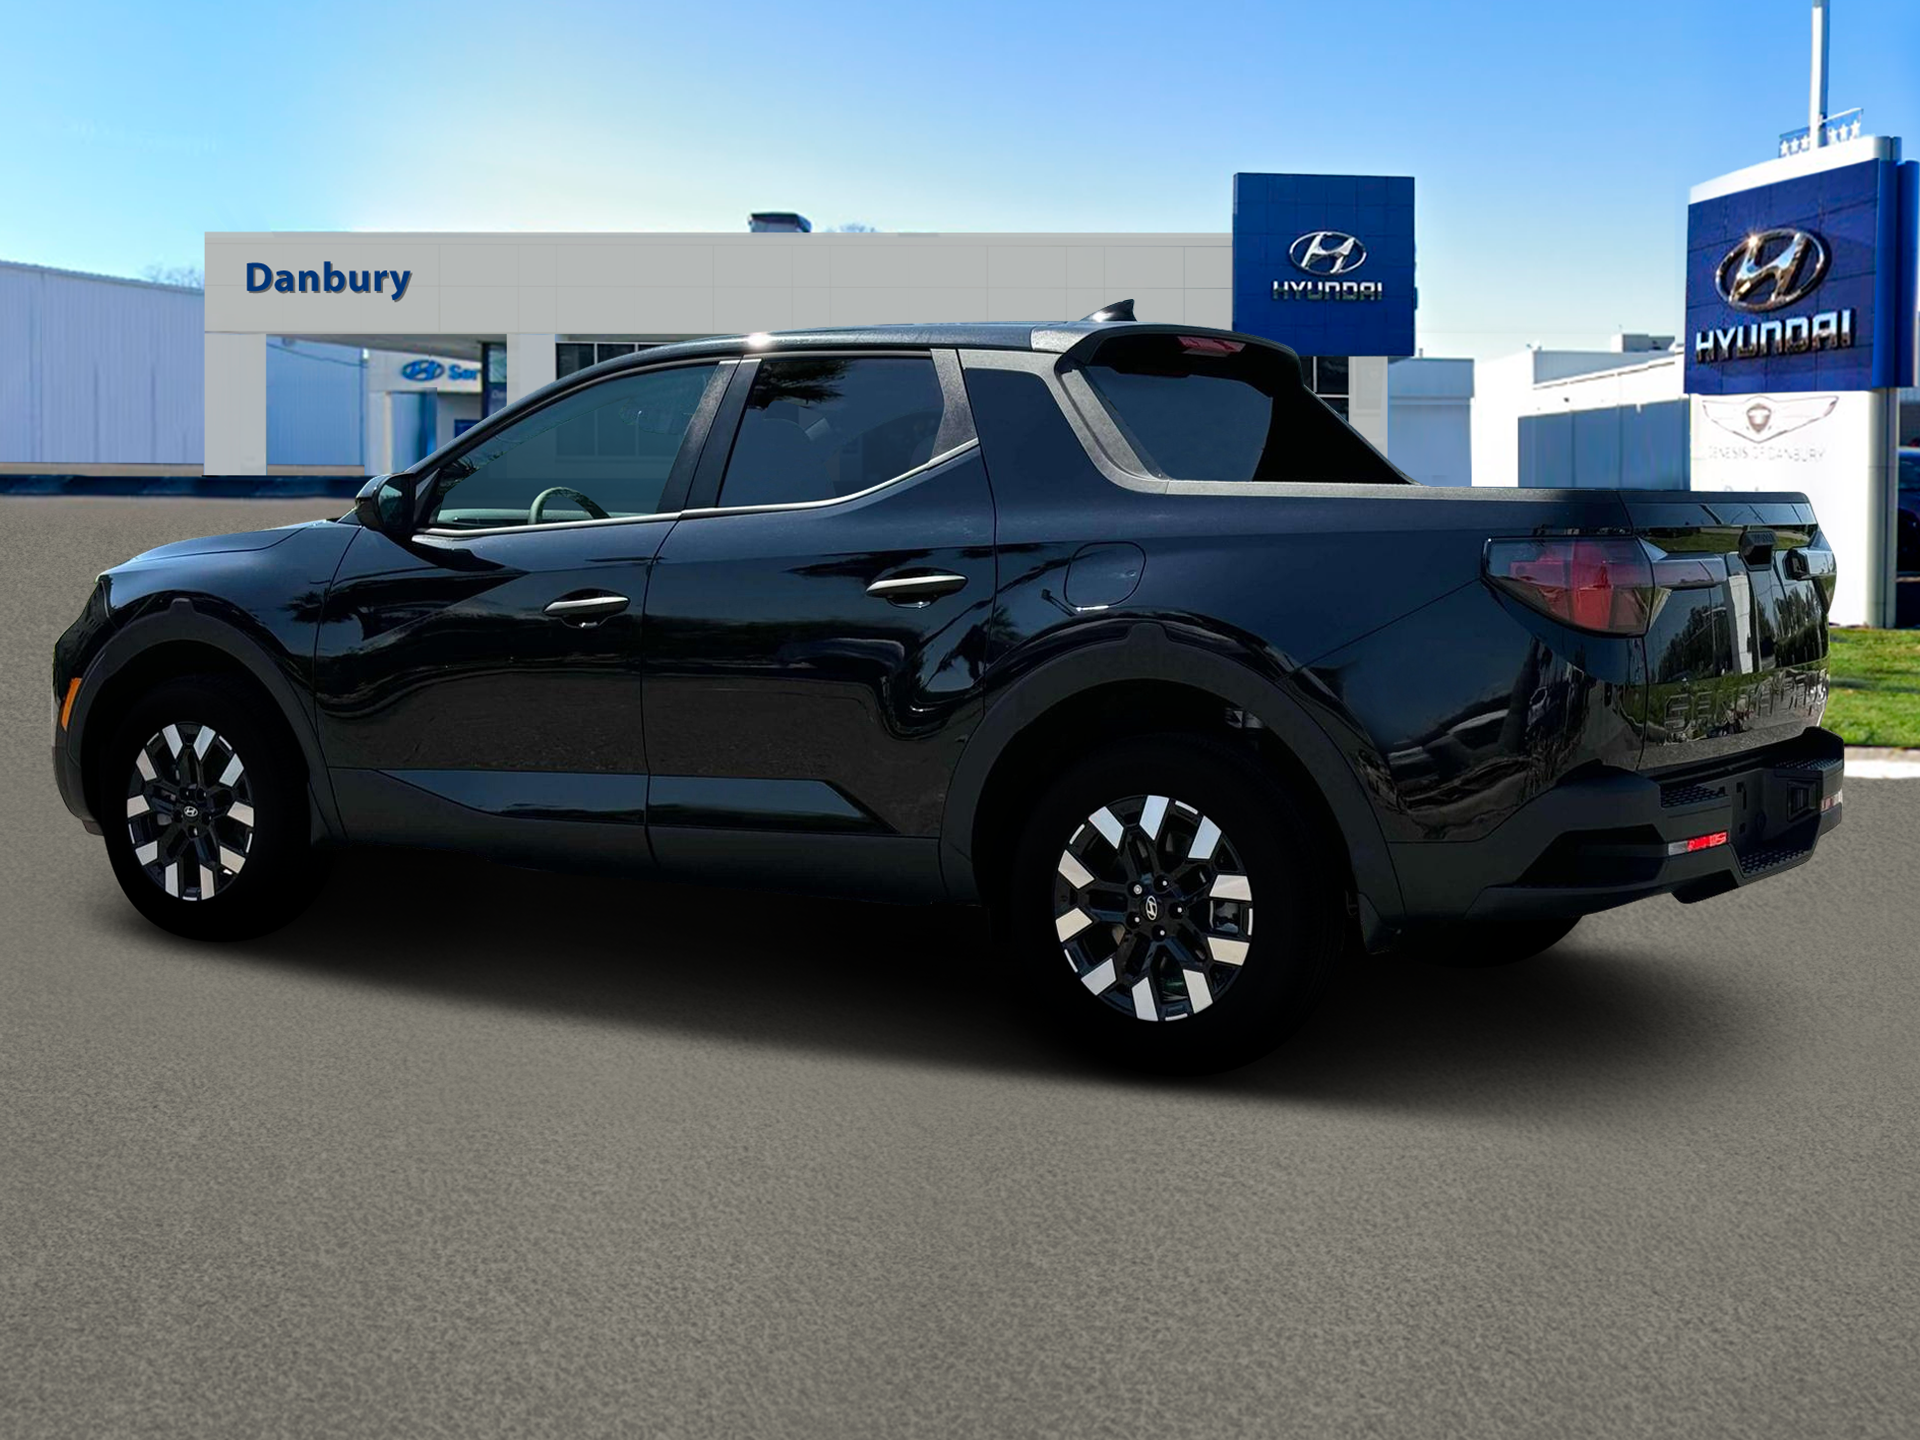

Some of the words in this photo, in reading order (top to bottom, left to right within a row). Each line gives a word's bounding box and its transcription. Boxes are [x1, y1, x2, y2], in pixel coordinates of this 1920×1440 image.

[245, 261, 412, 302] Danbury
[1273, 281, 1382, 300] HYUNDAI
[1695, 309, 1855, 364] HYUNDAI
